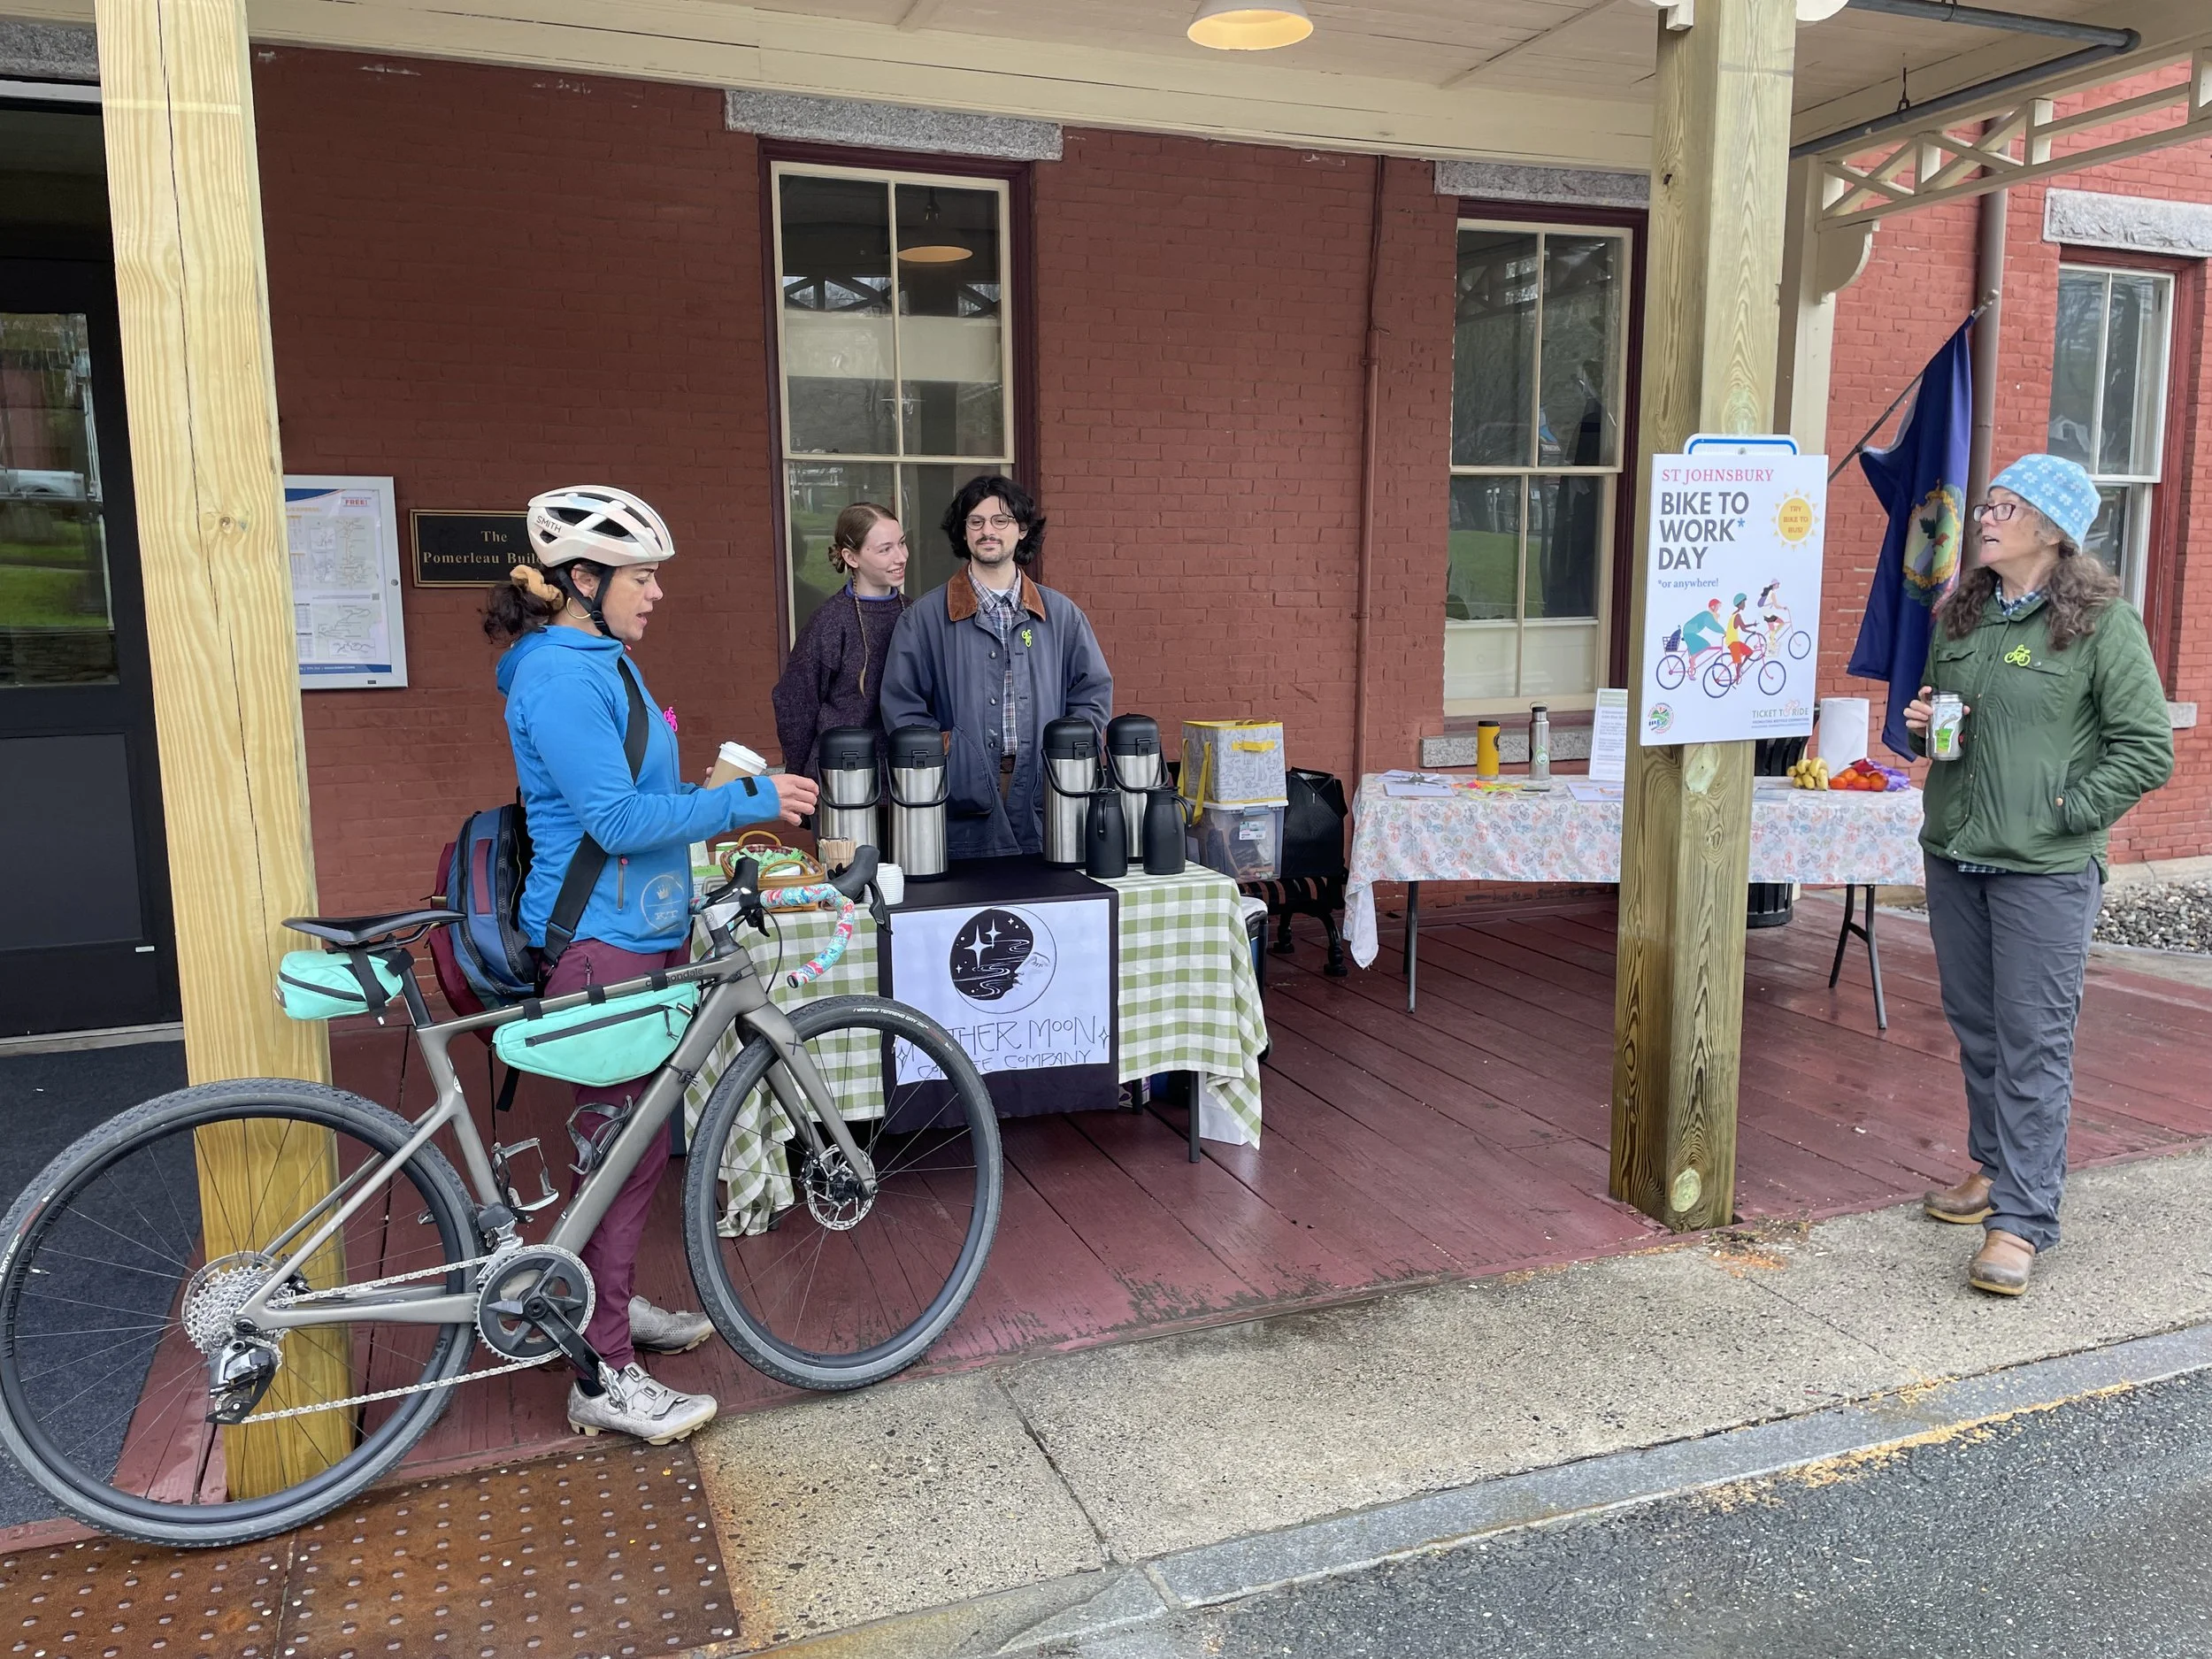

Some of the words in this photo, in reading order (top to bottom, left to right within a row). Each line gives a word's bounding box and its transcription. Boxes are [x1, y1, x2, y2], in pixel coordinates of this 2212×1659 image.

[1662, 469, 1681, 482] ST
[1683, 469, 1774, 485] JOHNSBURY
[1661, 491, 1712, 515] BIKE
[1718, 491, 1749, 515] TO
[535, 515, 562, 534] SMITH
[480, 530, 508, 542] The
[423, 551, 499, 564] Pomerleau
[1658, 546, 1709, 570] DAY
[1673, 578, 1719, 590] anywhere!
[1752, 709, 1778, 718] TICKET
[1792, 707, 1809, 717] RIDE
[645, 968, 704, 987] condale
[910, 1021, 1022, 1062] THER
